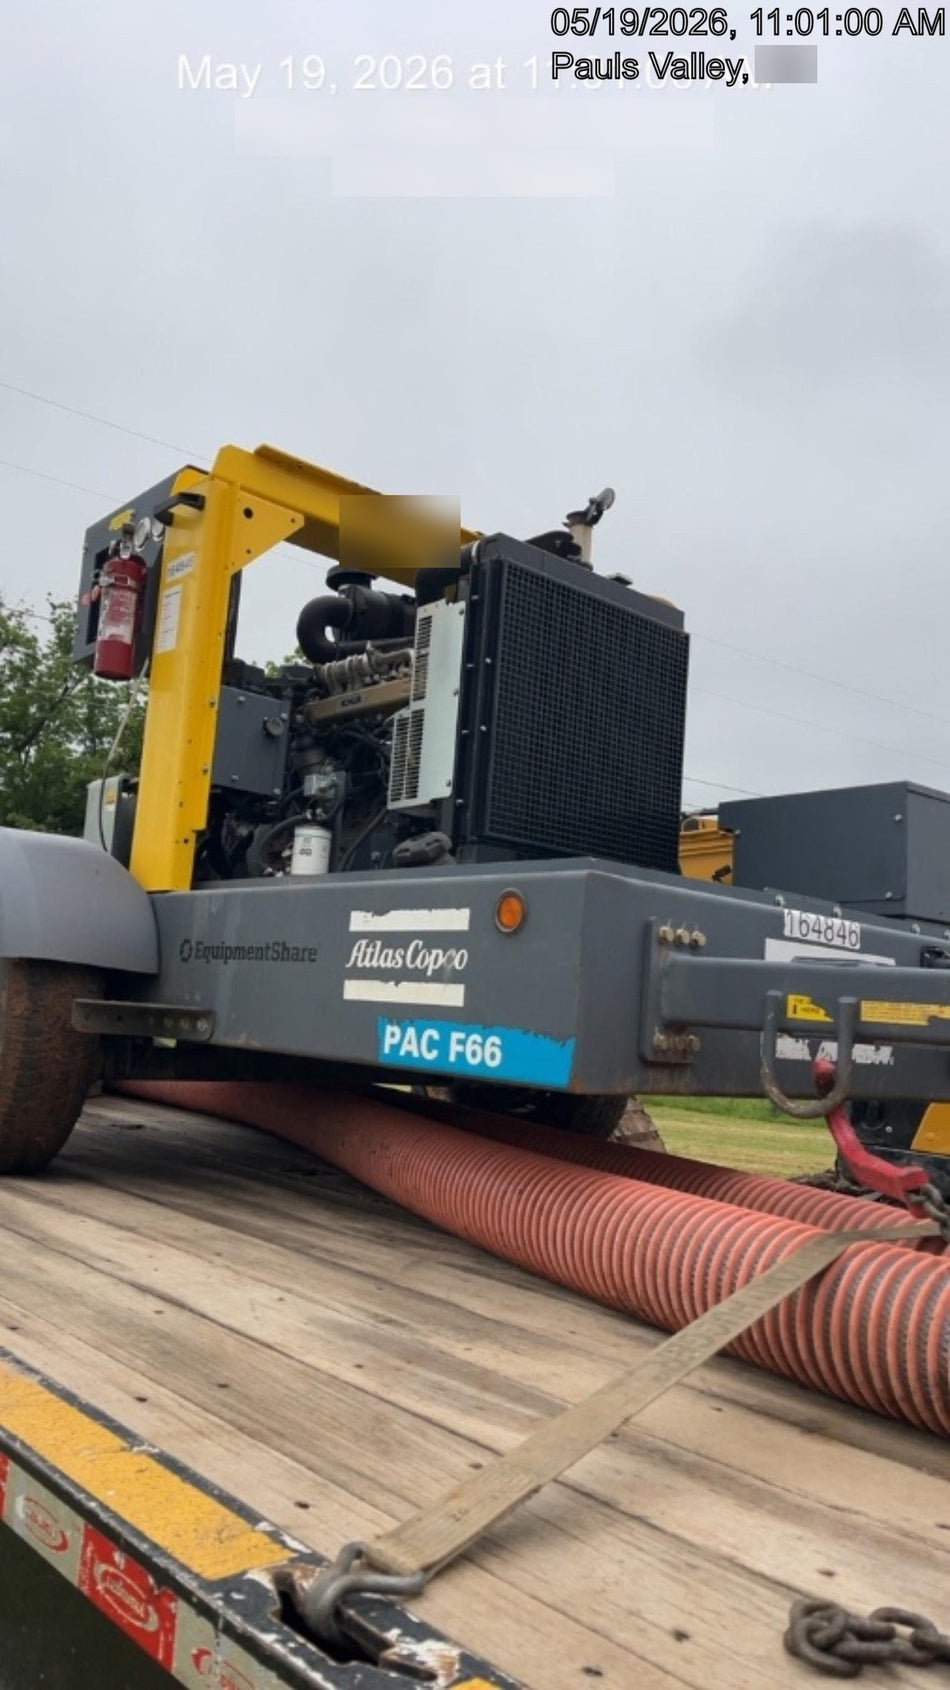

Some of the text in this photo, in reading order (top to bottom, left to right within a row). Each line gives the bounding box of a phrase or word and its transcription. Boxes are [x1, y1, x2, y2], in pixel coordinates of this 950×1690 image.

[786, 912, 860, 949] 164846
[194, 940, 318, 965] EquipmentShare
[345, 938, 469, 977] Atlas Copco
[383, 1024, 503, 1068] PAC F66
